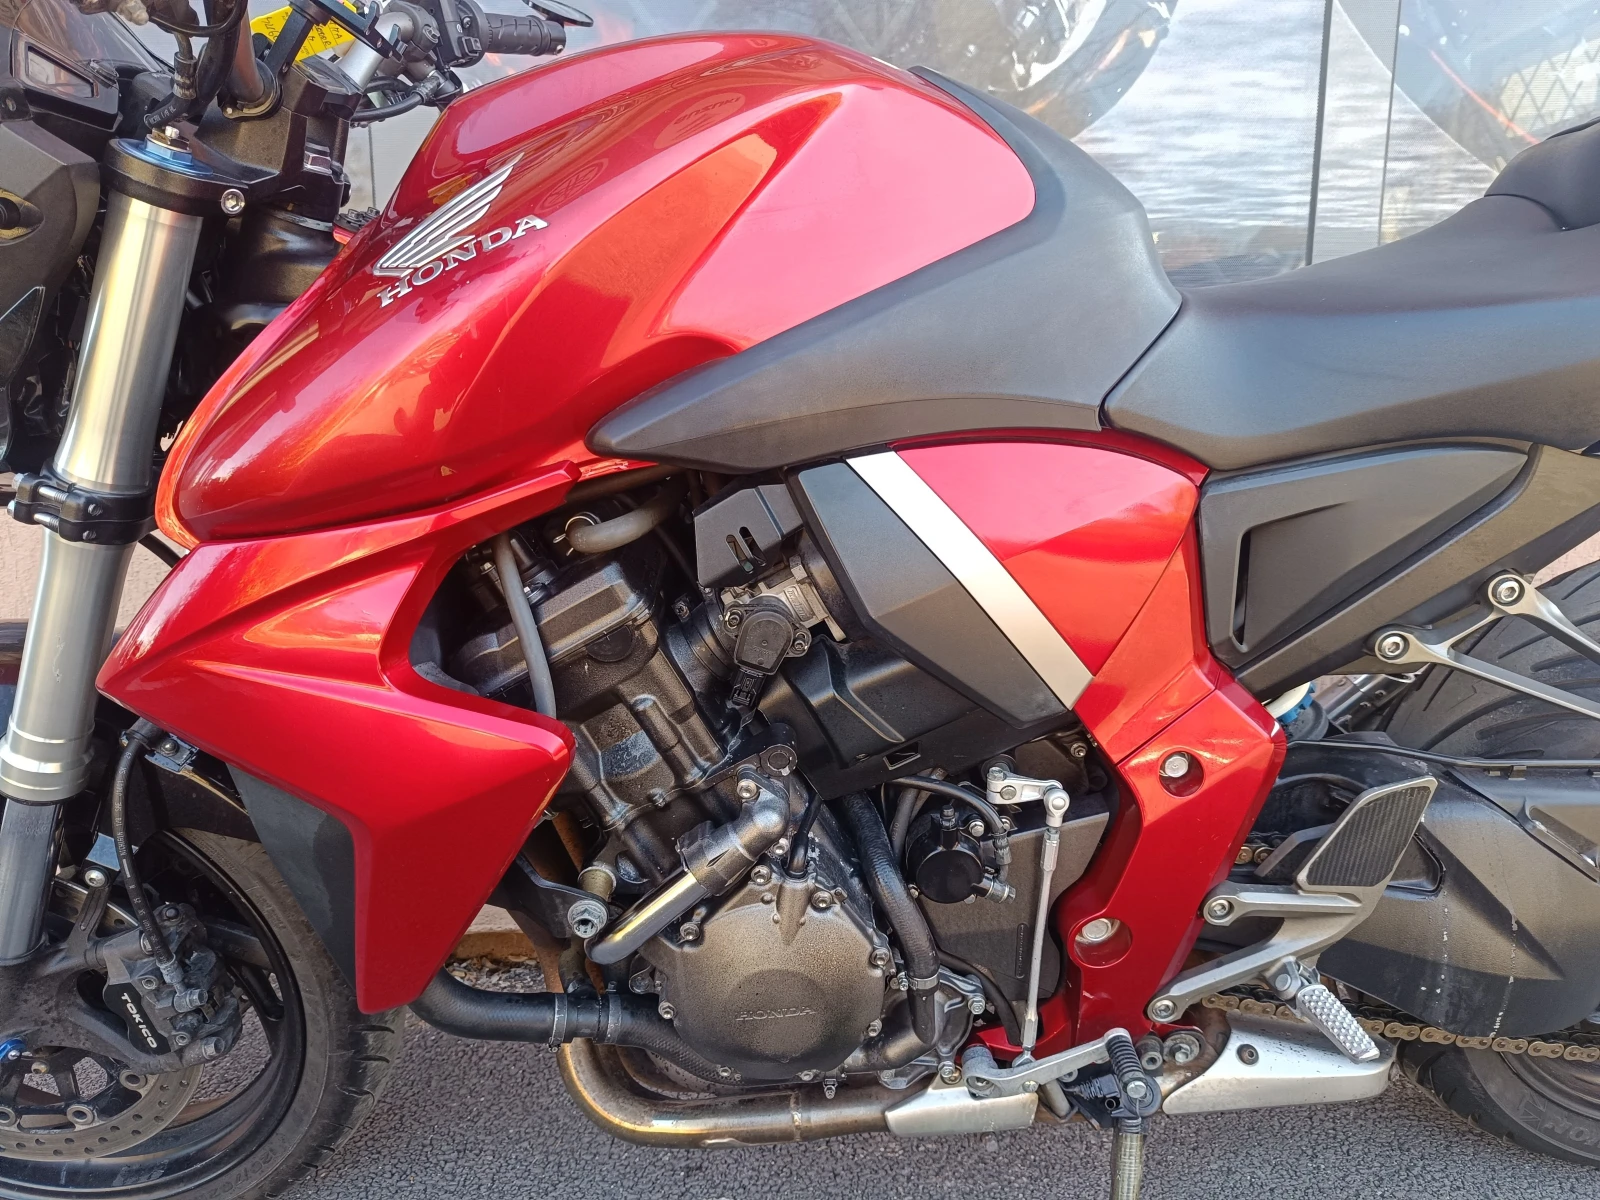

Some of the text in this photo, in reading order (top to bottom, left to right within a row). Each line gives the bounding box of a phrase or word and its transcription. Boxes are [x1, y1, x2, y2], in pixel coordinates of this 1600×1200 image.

[376, 214, 549, 308] HONDA
[114, 801, 122, 812] SAE
[120, 992, 158, 1048] TOKICO
[735, 1006, 817, 1021] HONDA
